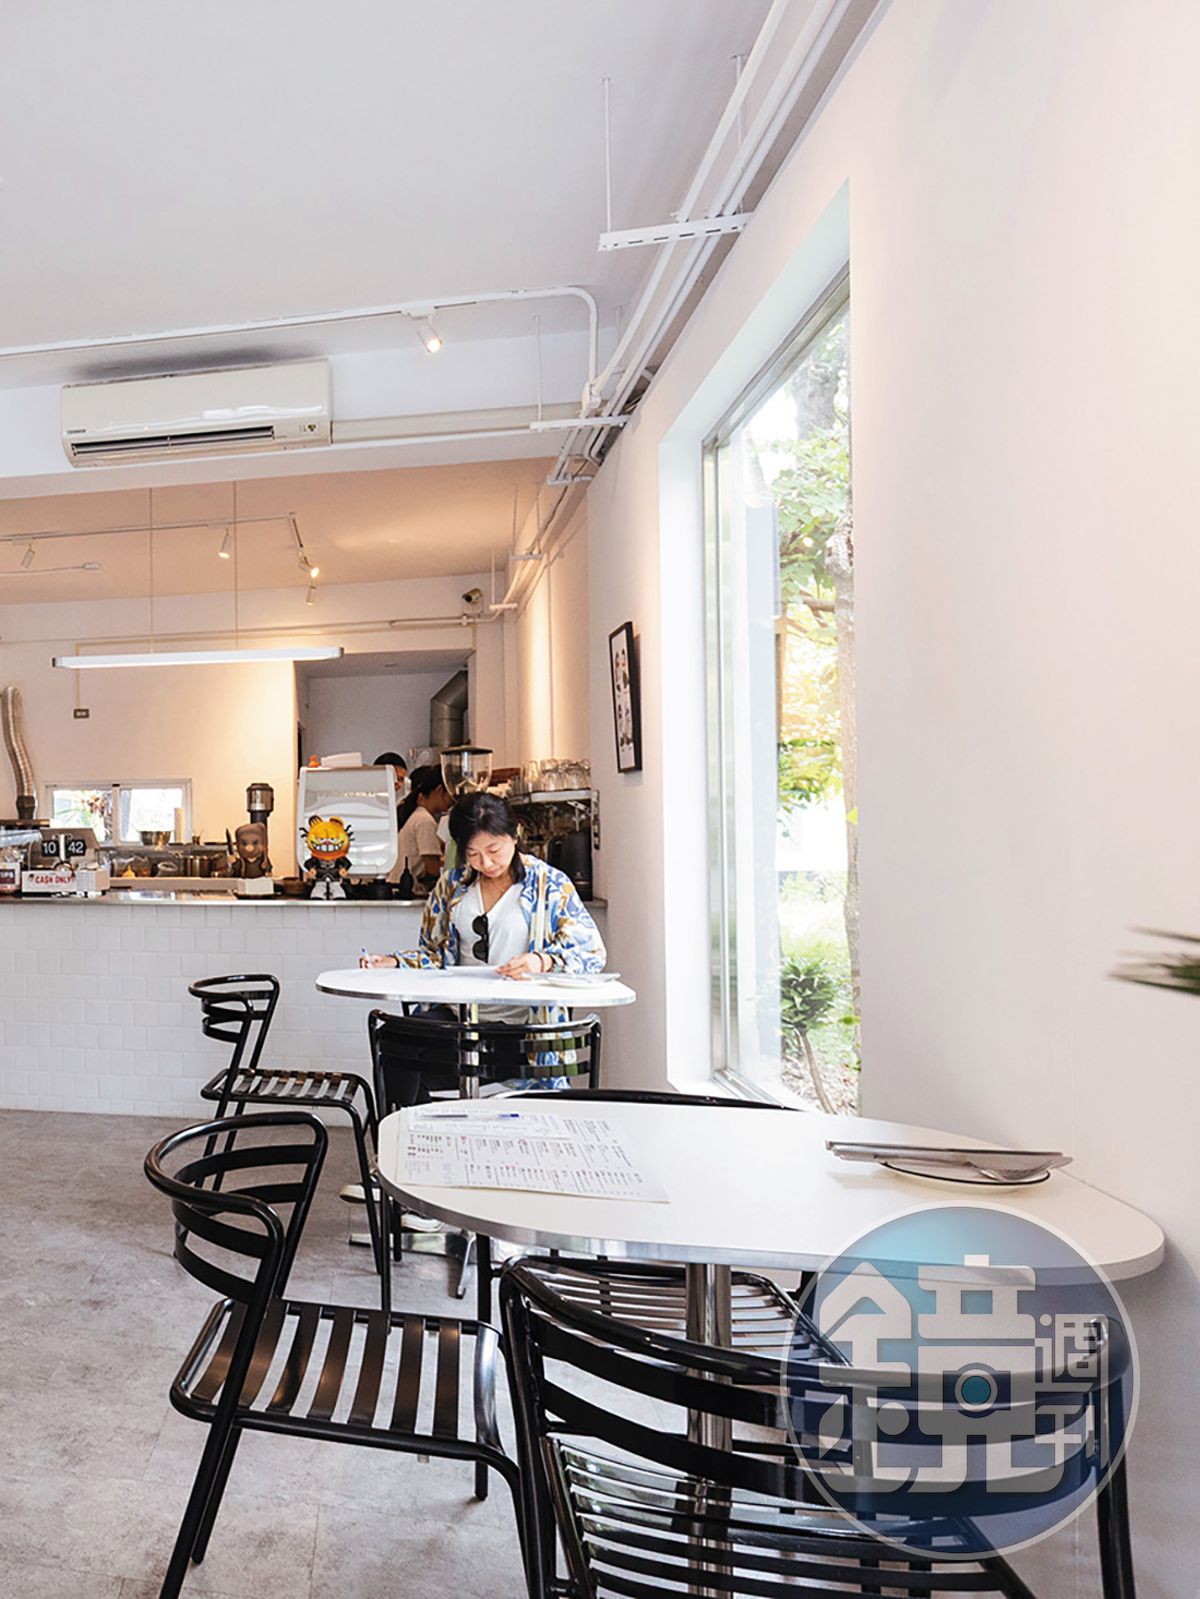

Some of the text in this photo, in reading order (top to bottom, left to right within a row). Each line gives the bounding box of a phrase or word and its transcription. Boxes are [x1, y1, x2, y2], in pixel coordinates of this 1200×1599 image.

[43, 841, 84, 854] 10 42
[55, 875, 71, 884] ONLY
